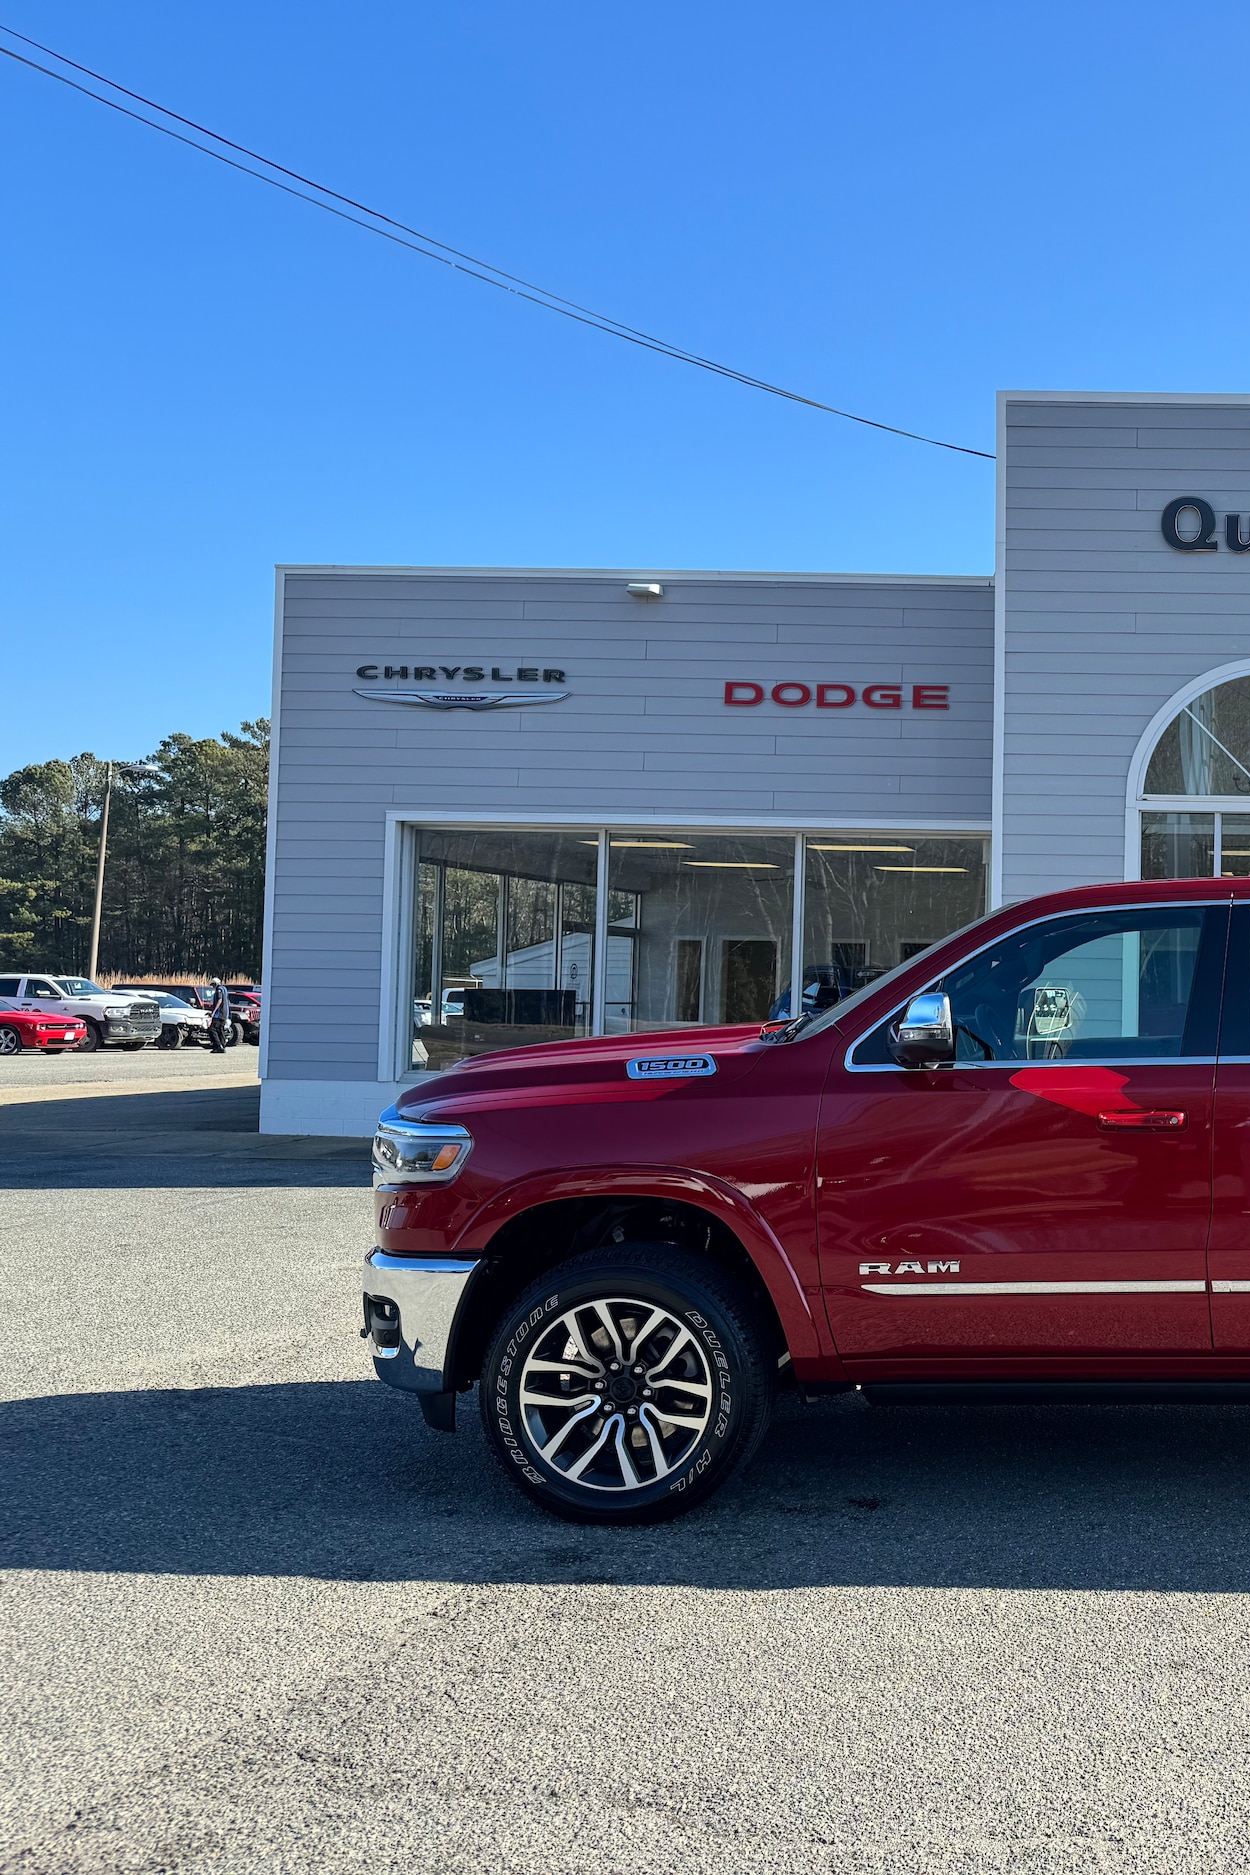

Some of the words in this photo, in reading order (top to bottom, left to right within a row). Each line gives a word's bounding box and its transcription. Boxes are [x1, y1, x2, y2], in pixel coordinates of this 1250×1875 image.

[356, 665, 566, 683] CHRYSLER
[724, 681, 949, 710] DODGE
[641, 1060, 704, 1071] 1500
[859, 1260, 961, 1275] RAM
[685, 1311, 732, 1438] DUELER
[497, 1294, 559, 1484] BRIDGESTONE
